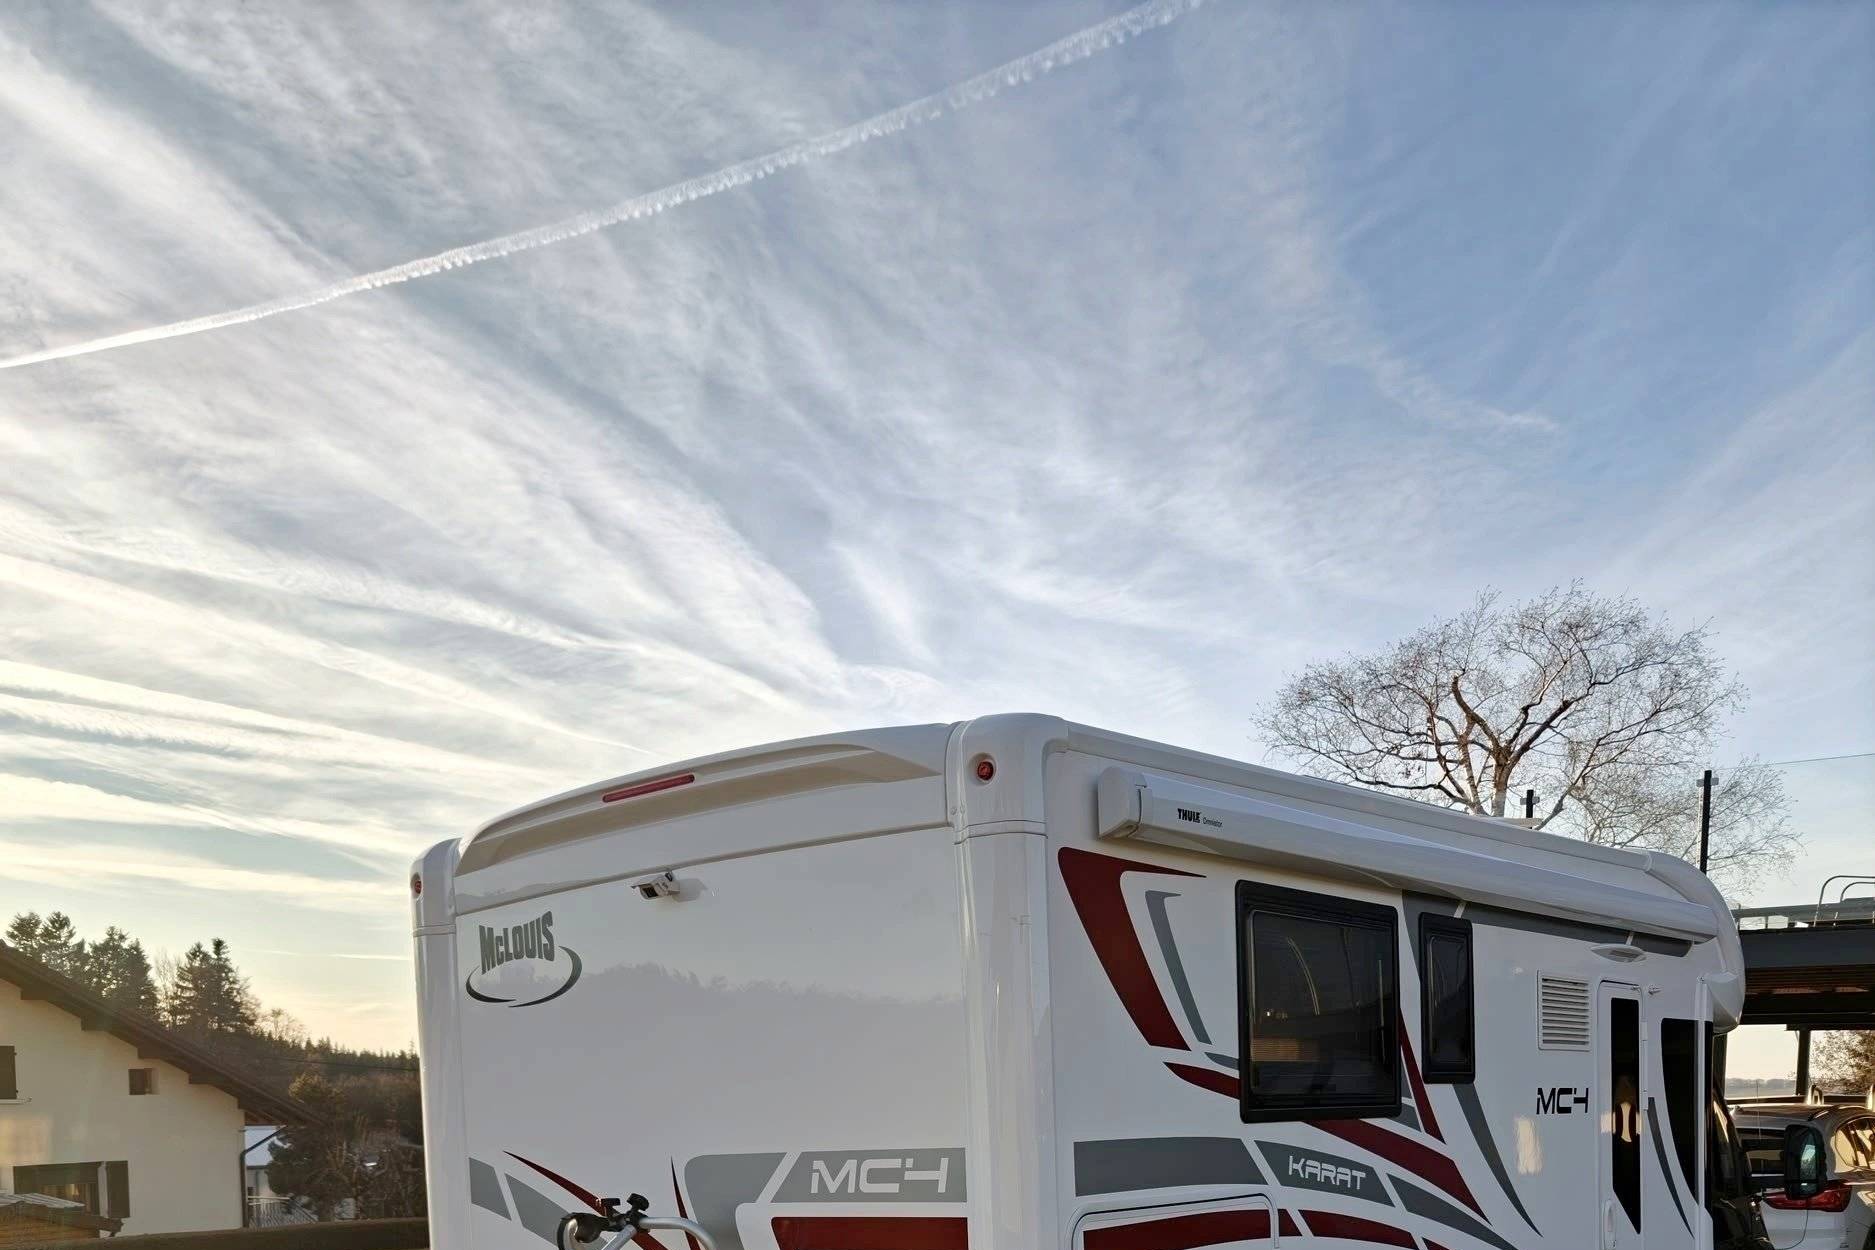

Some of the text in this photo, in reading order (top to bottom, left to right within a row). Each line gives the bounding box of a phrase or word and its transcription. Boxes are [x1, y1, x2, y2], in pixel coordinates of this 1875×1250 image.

[1177, 808, 1201, 823] THULE
[479, 911, 555, 975] McLOUIS
[1536, 1087, 1589, 1115] MC4
[811, 1158, 949, 1194] MC4
[1288, 1155, 1366, 1190] KARAT
